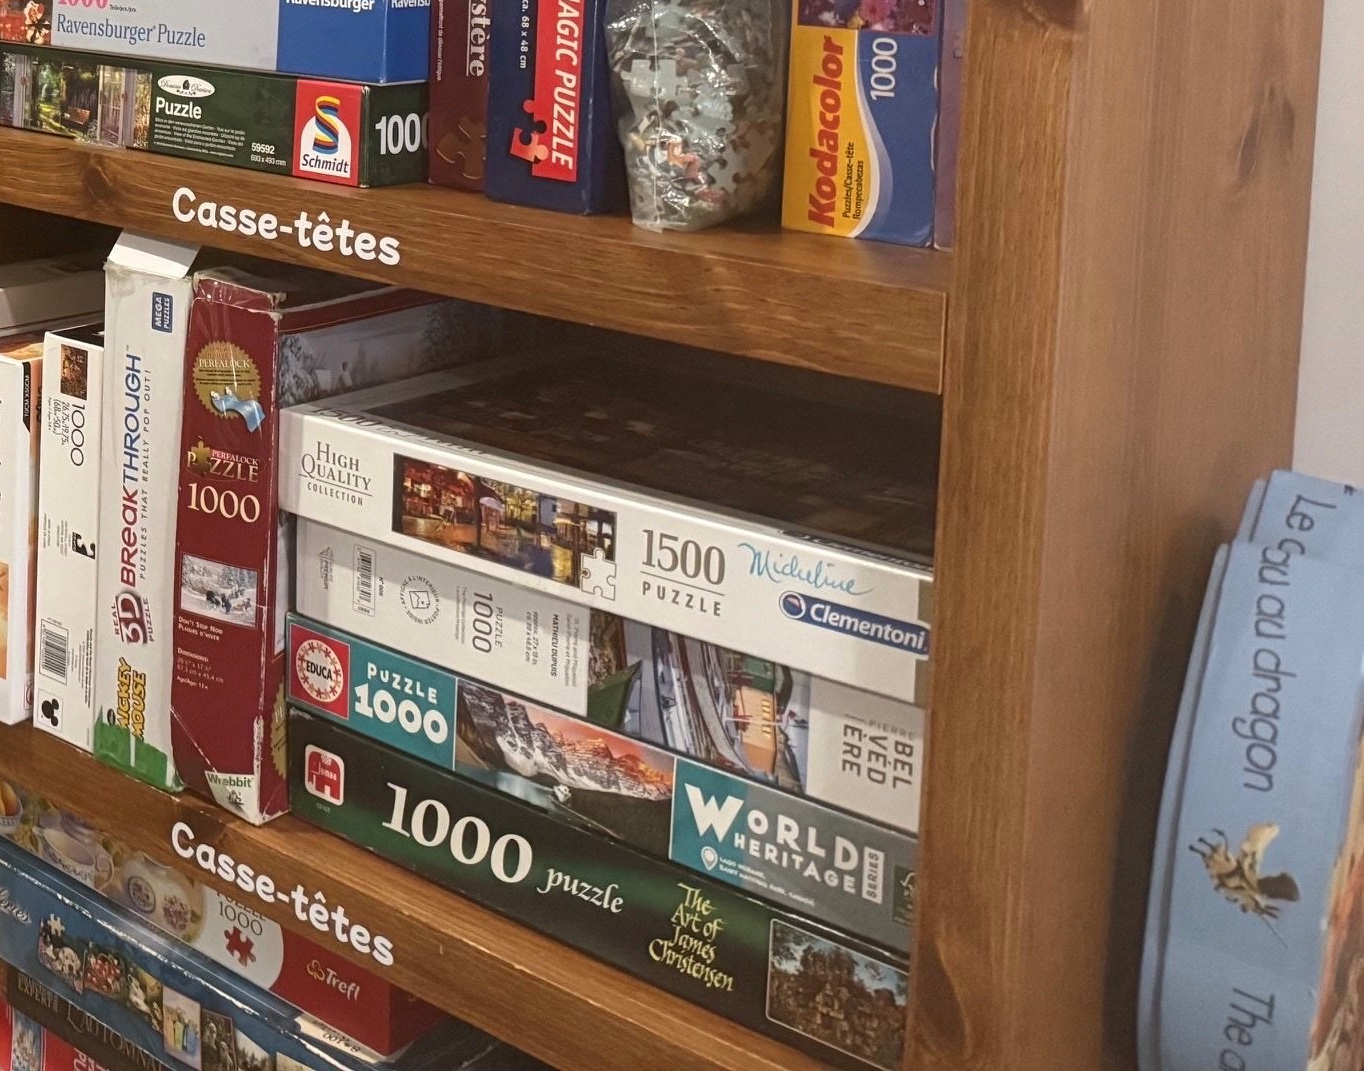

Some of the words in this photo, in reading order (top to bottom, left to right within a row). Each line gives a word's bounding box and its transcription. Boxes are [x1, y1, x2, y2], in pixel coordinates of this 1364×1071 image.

[56, 12, 151, 44] Ravensburger
[157, 22, 206, 49] Puzzle
[521, 15, 530, 28] 68
[519, 57, 527, 69] cm
[520, 40, 528, 53] 48
[871, 38, 898, 100] 1000
[155, 97, 202, 119] Puzzle
[551, 69, 577, 170] PUZZLE
[251, 142, 275, 155] 59592
[808, 34, 844, 227] Kodacolor
[301, 153, 350, 173] Schmidt
[842, 141, 854, 219] Puzzles/Casse-tête
[852, 159, 864, 219] Rompecabezas
[172, 187, 401, 266] Casse-têtes
[71, 404, 85, 466] 1000
[139, 527, 147, 579] PUZZLES
[144, 369, 152, 402] OUT!
[212, 450, 258, 465] PERFALOCK
[300, 455, 372, 493] QUALITY
[316, 441, 360, 472] HIGH
[188, 483, 260, 523] 1000
[307, 482, 364, 506] COLLECTION
[1286, 495, 1337, 530] Le
[641, 528, 726, 587] 1500
[111, 602, 119, 635] REAL
[116, 591, 148, 645] 3D
[642, 580, 722, 618] PUZZLE
[472, 591, 493, 654] 1000
[495, 607, 504, 649] PUZZLE
[810, 601, 926, 649] Clementoni
[306, 660, 333, 681] EDUCA
[366, 661, 438, 704] PUZZLE
[353, 683, 449, 744] 1000
[1232, 649, 1296, 793] dragon
[207, 774, 252, 788] Wrebbit
[381, 781, 533, 883] 1000
[537, 868, 624, 914] puzzle
[684, 783, 858, 871] WORLD
[734, 833, 857, 894] HERITAGE
[866, 852, 879, 898] SERIES
[171, 820, 395, 967] Casse-têtes
[676, 882, 718, 916] The
[218, 898, 264, 936] 1000
[670, 898, 704, 930] Art
[705, 919, 725, 940] of
[648, 939, 734, 992] Christensen
[673, 927, 716, 963] James
[325, 967, 361, 1001] Trefl
[1222, 987, 1275, 1048] The
